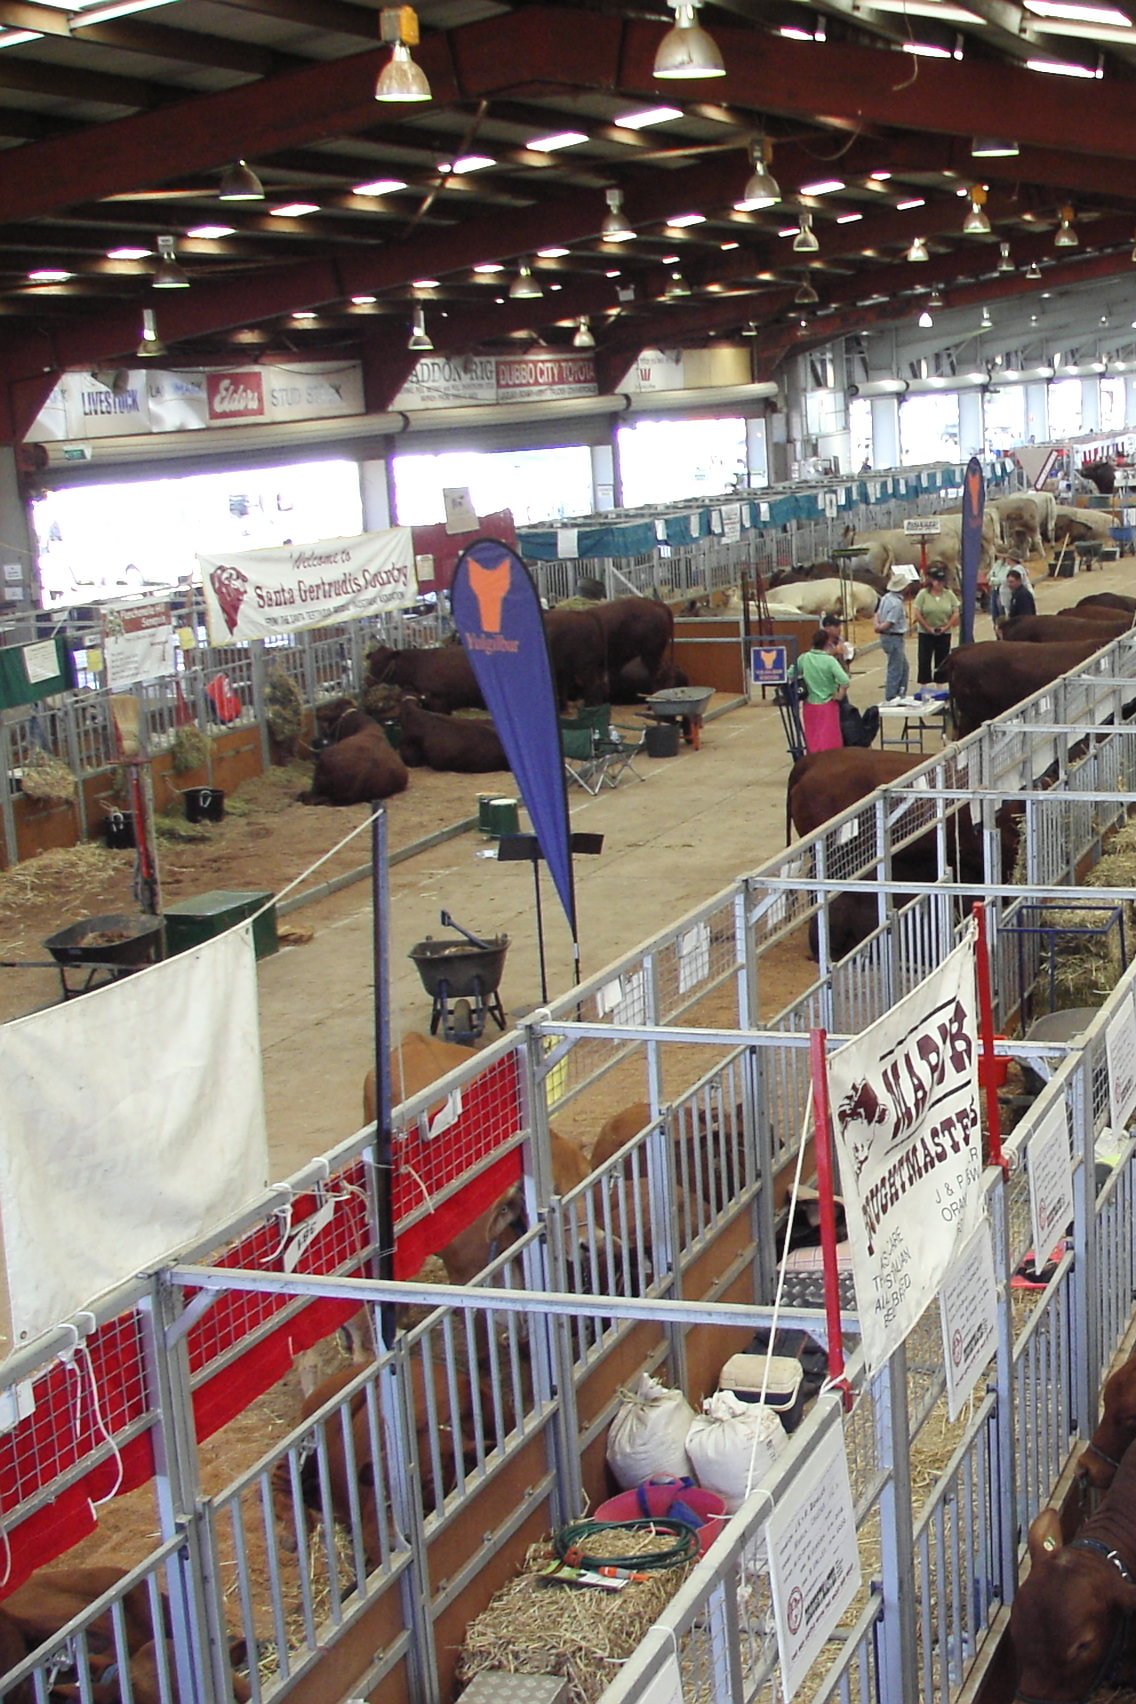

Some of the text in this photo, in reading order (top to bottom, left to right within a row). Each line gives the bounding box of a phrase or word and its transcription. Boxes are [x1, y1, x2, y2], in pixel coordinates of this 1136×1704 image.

[409, 360, 495, 383] ADDON RIG
[500, 361, 596, 385] DUBBO CITY TOYOTA
[214, 378, 259, 414] Elders
[291, 551, 338, 570] Welcome
[254, 583, 295, 608] Santa
[299, 572, 362, 603] Gertrudis
[362, 562, 409, 593] Country
